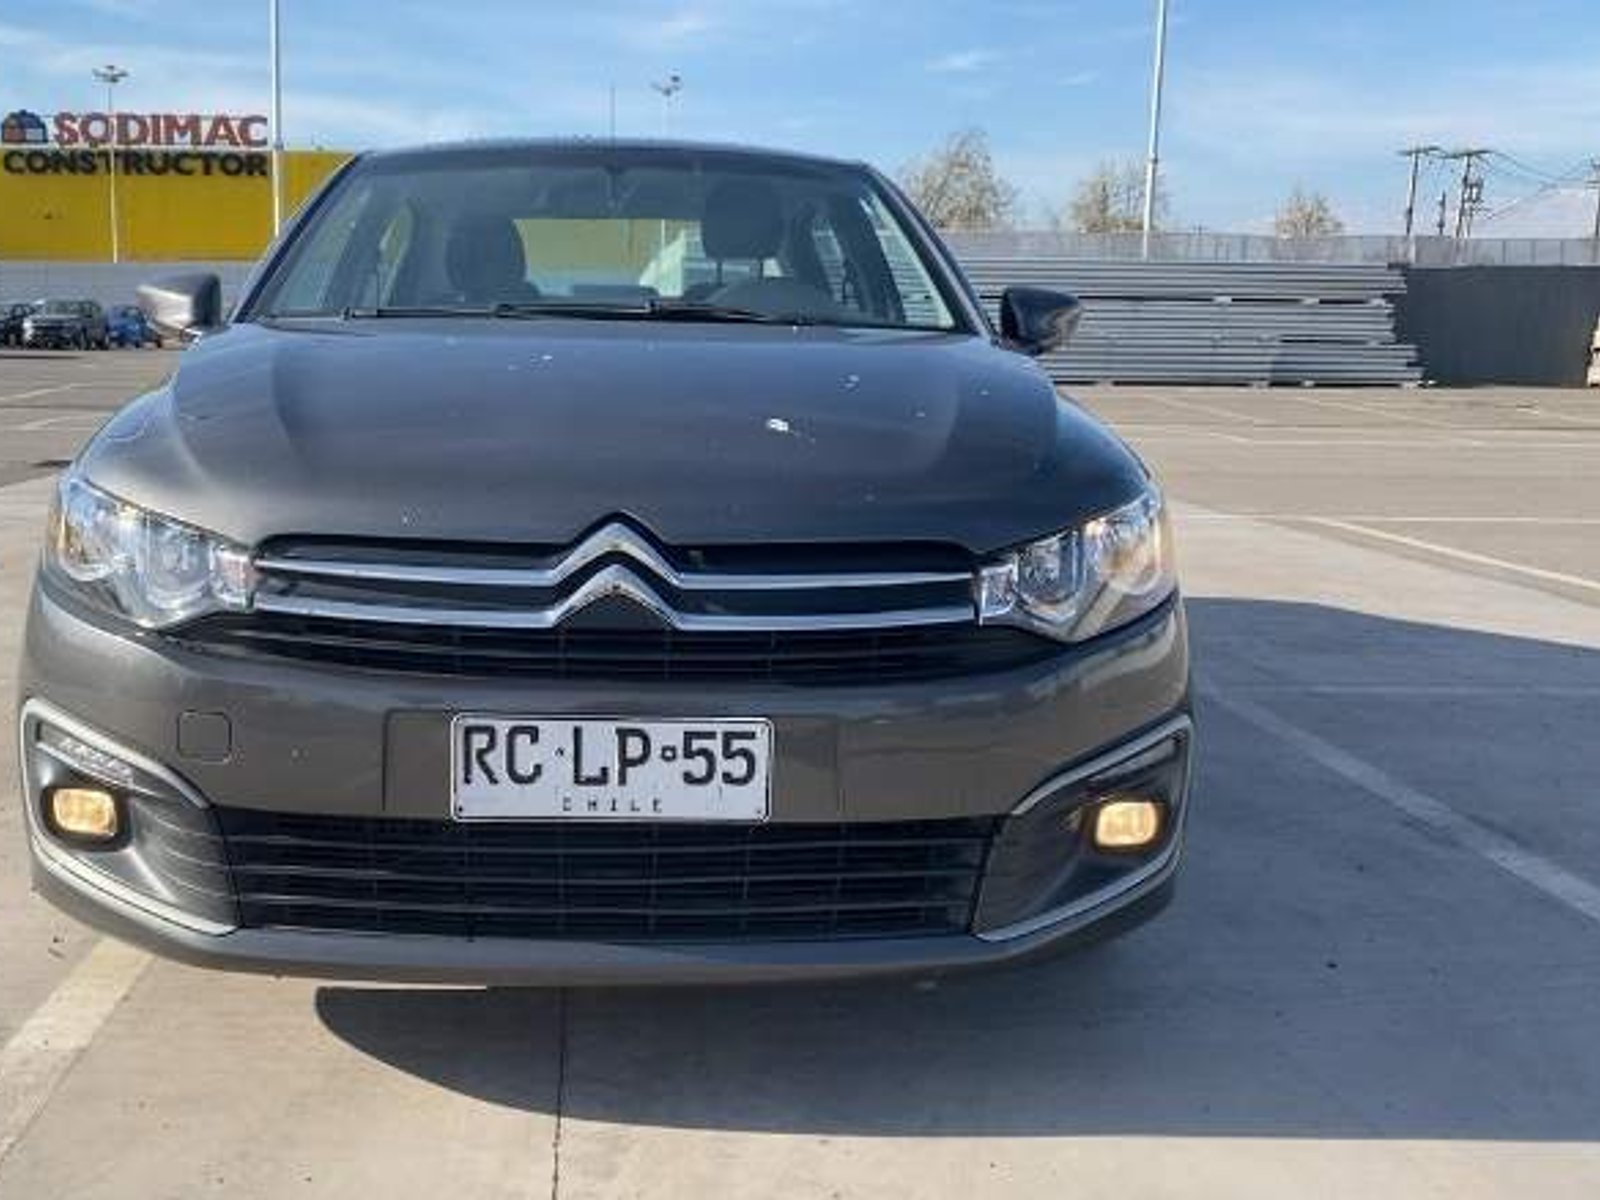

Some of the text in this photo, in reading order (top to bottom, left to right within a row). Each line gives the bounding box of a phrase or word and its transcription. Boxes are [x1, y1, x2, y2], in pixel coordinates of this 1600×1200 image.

[53, 111, 268, 147] SODIMAC
[3, 150, 268, 176] CONSTRUCTOR
[562, 797, 662, 812] CHILE
